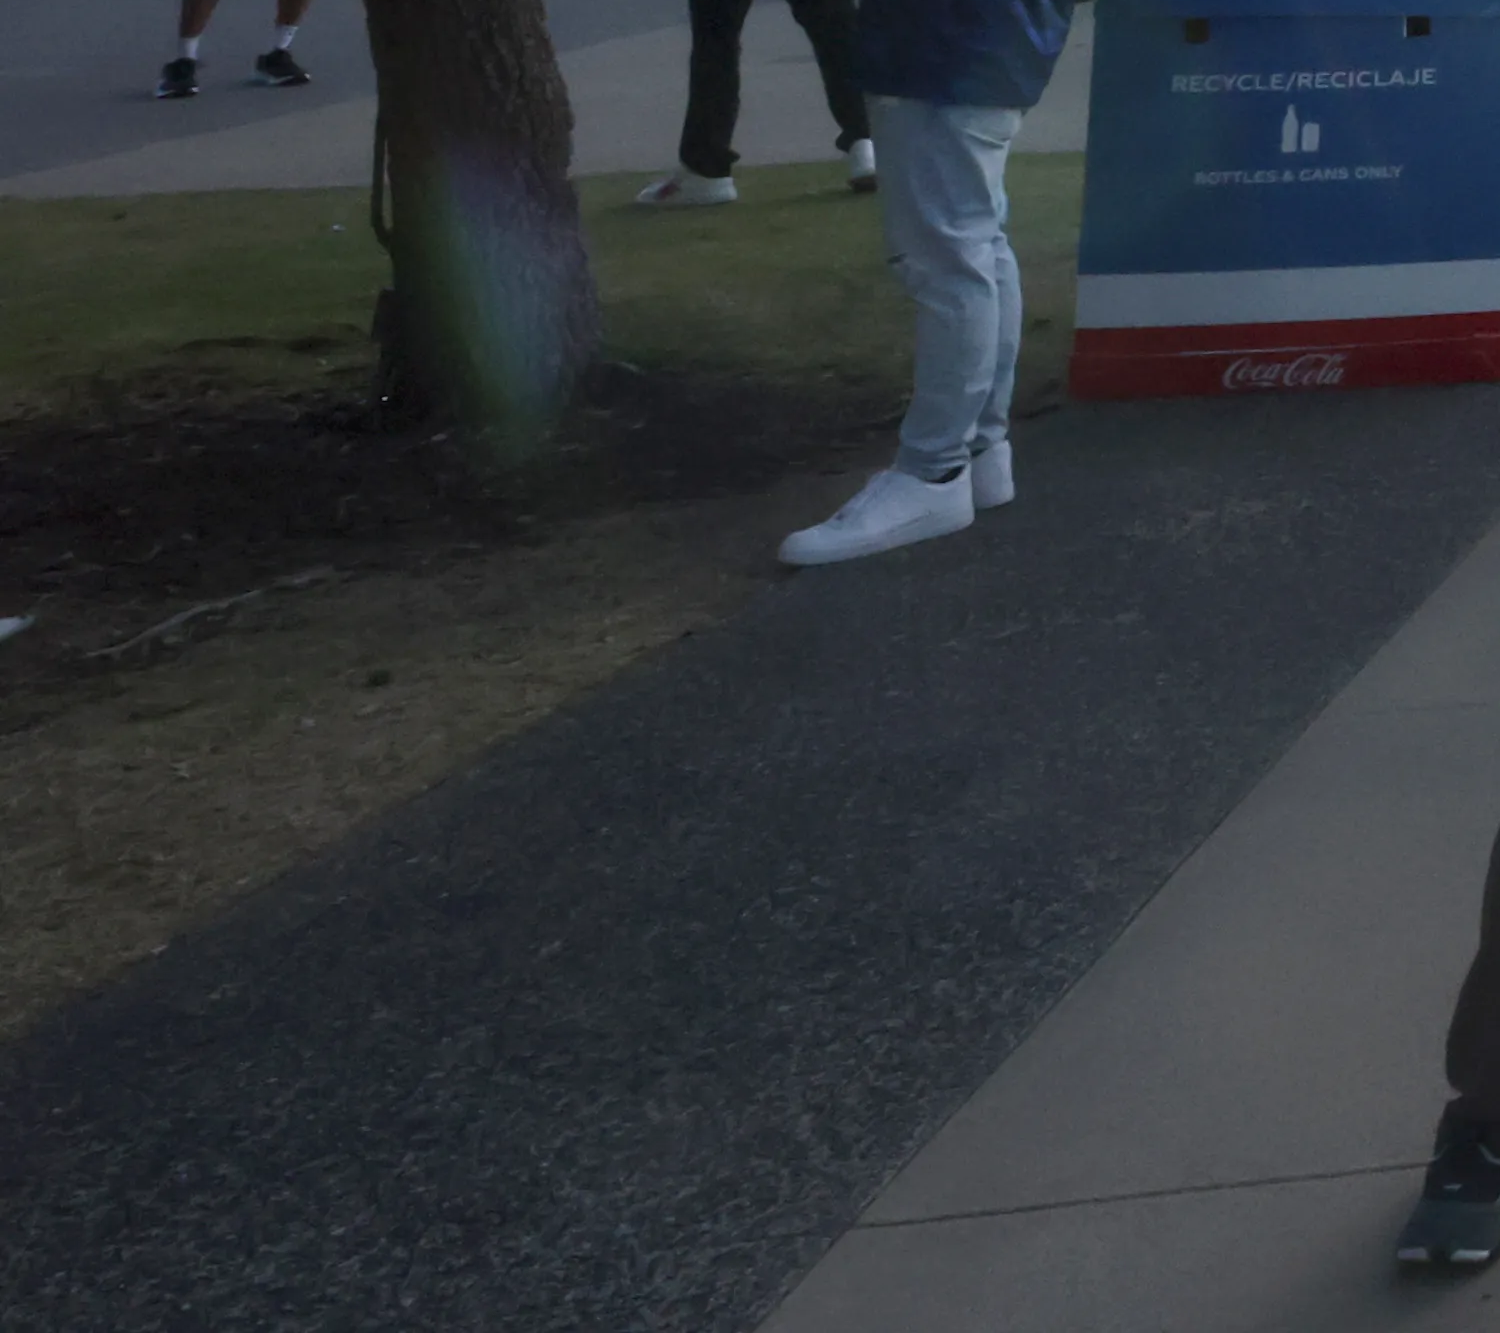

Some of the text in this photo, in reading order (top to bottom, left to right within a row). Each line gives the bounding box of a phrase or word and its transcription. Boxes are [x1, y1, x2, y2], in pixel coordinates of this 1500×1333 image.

[1171, 68, 1436, 94] RECYCLE/RECICLAJE
[1194, 164, 1403, 186] BOTTLES & CANS ONLY
[1223, 353, 1348, 388] Coca-Cola
